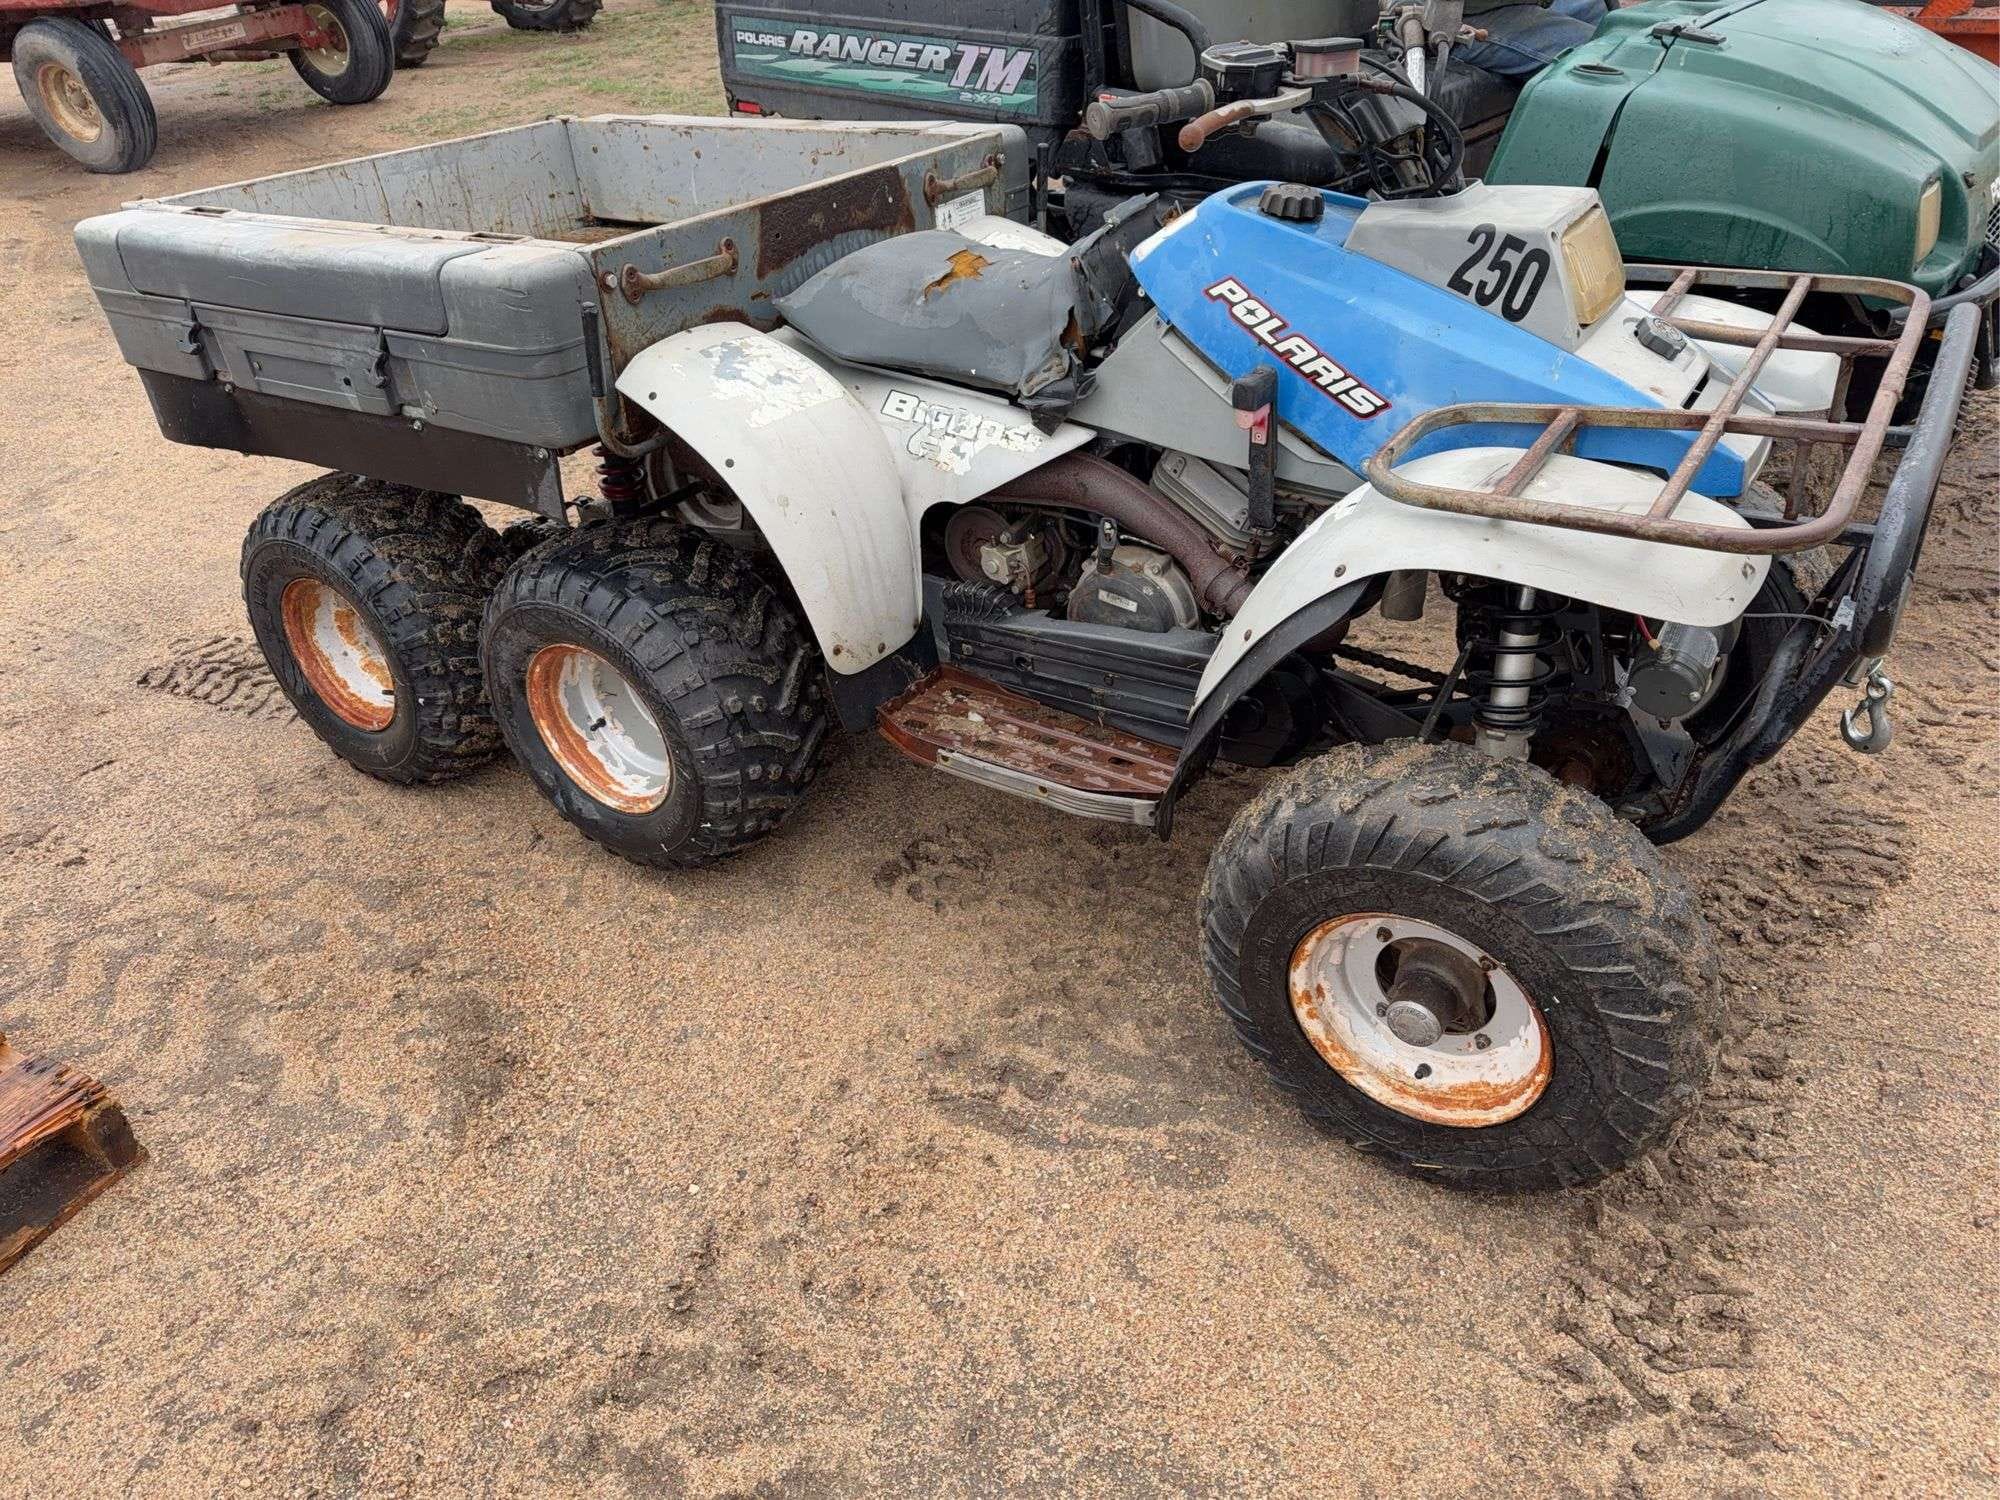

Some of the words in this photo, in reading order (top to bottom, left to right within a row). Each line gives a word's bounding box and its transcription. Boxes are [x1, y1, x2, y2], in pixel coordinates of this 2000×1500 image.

[736, 30, 786, 48] POLARIS
[789, 29, 951, 73] RANGER
[949, 43, 1033, 95] TM
[1446, 223, 1551, 323] 250
[1206, 277, 1390, 417] POLARIS
